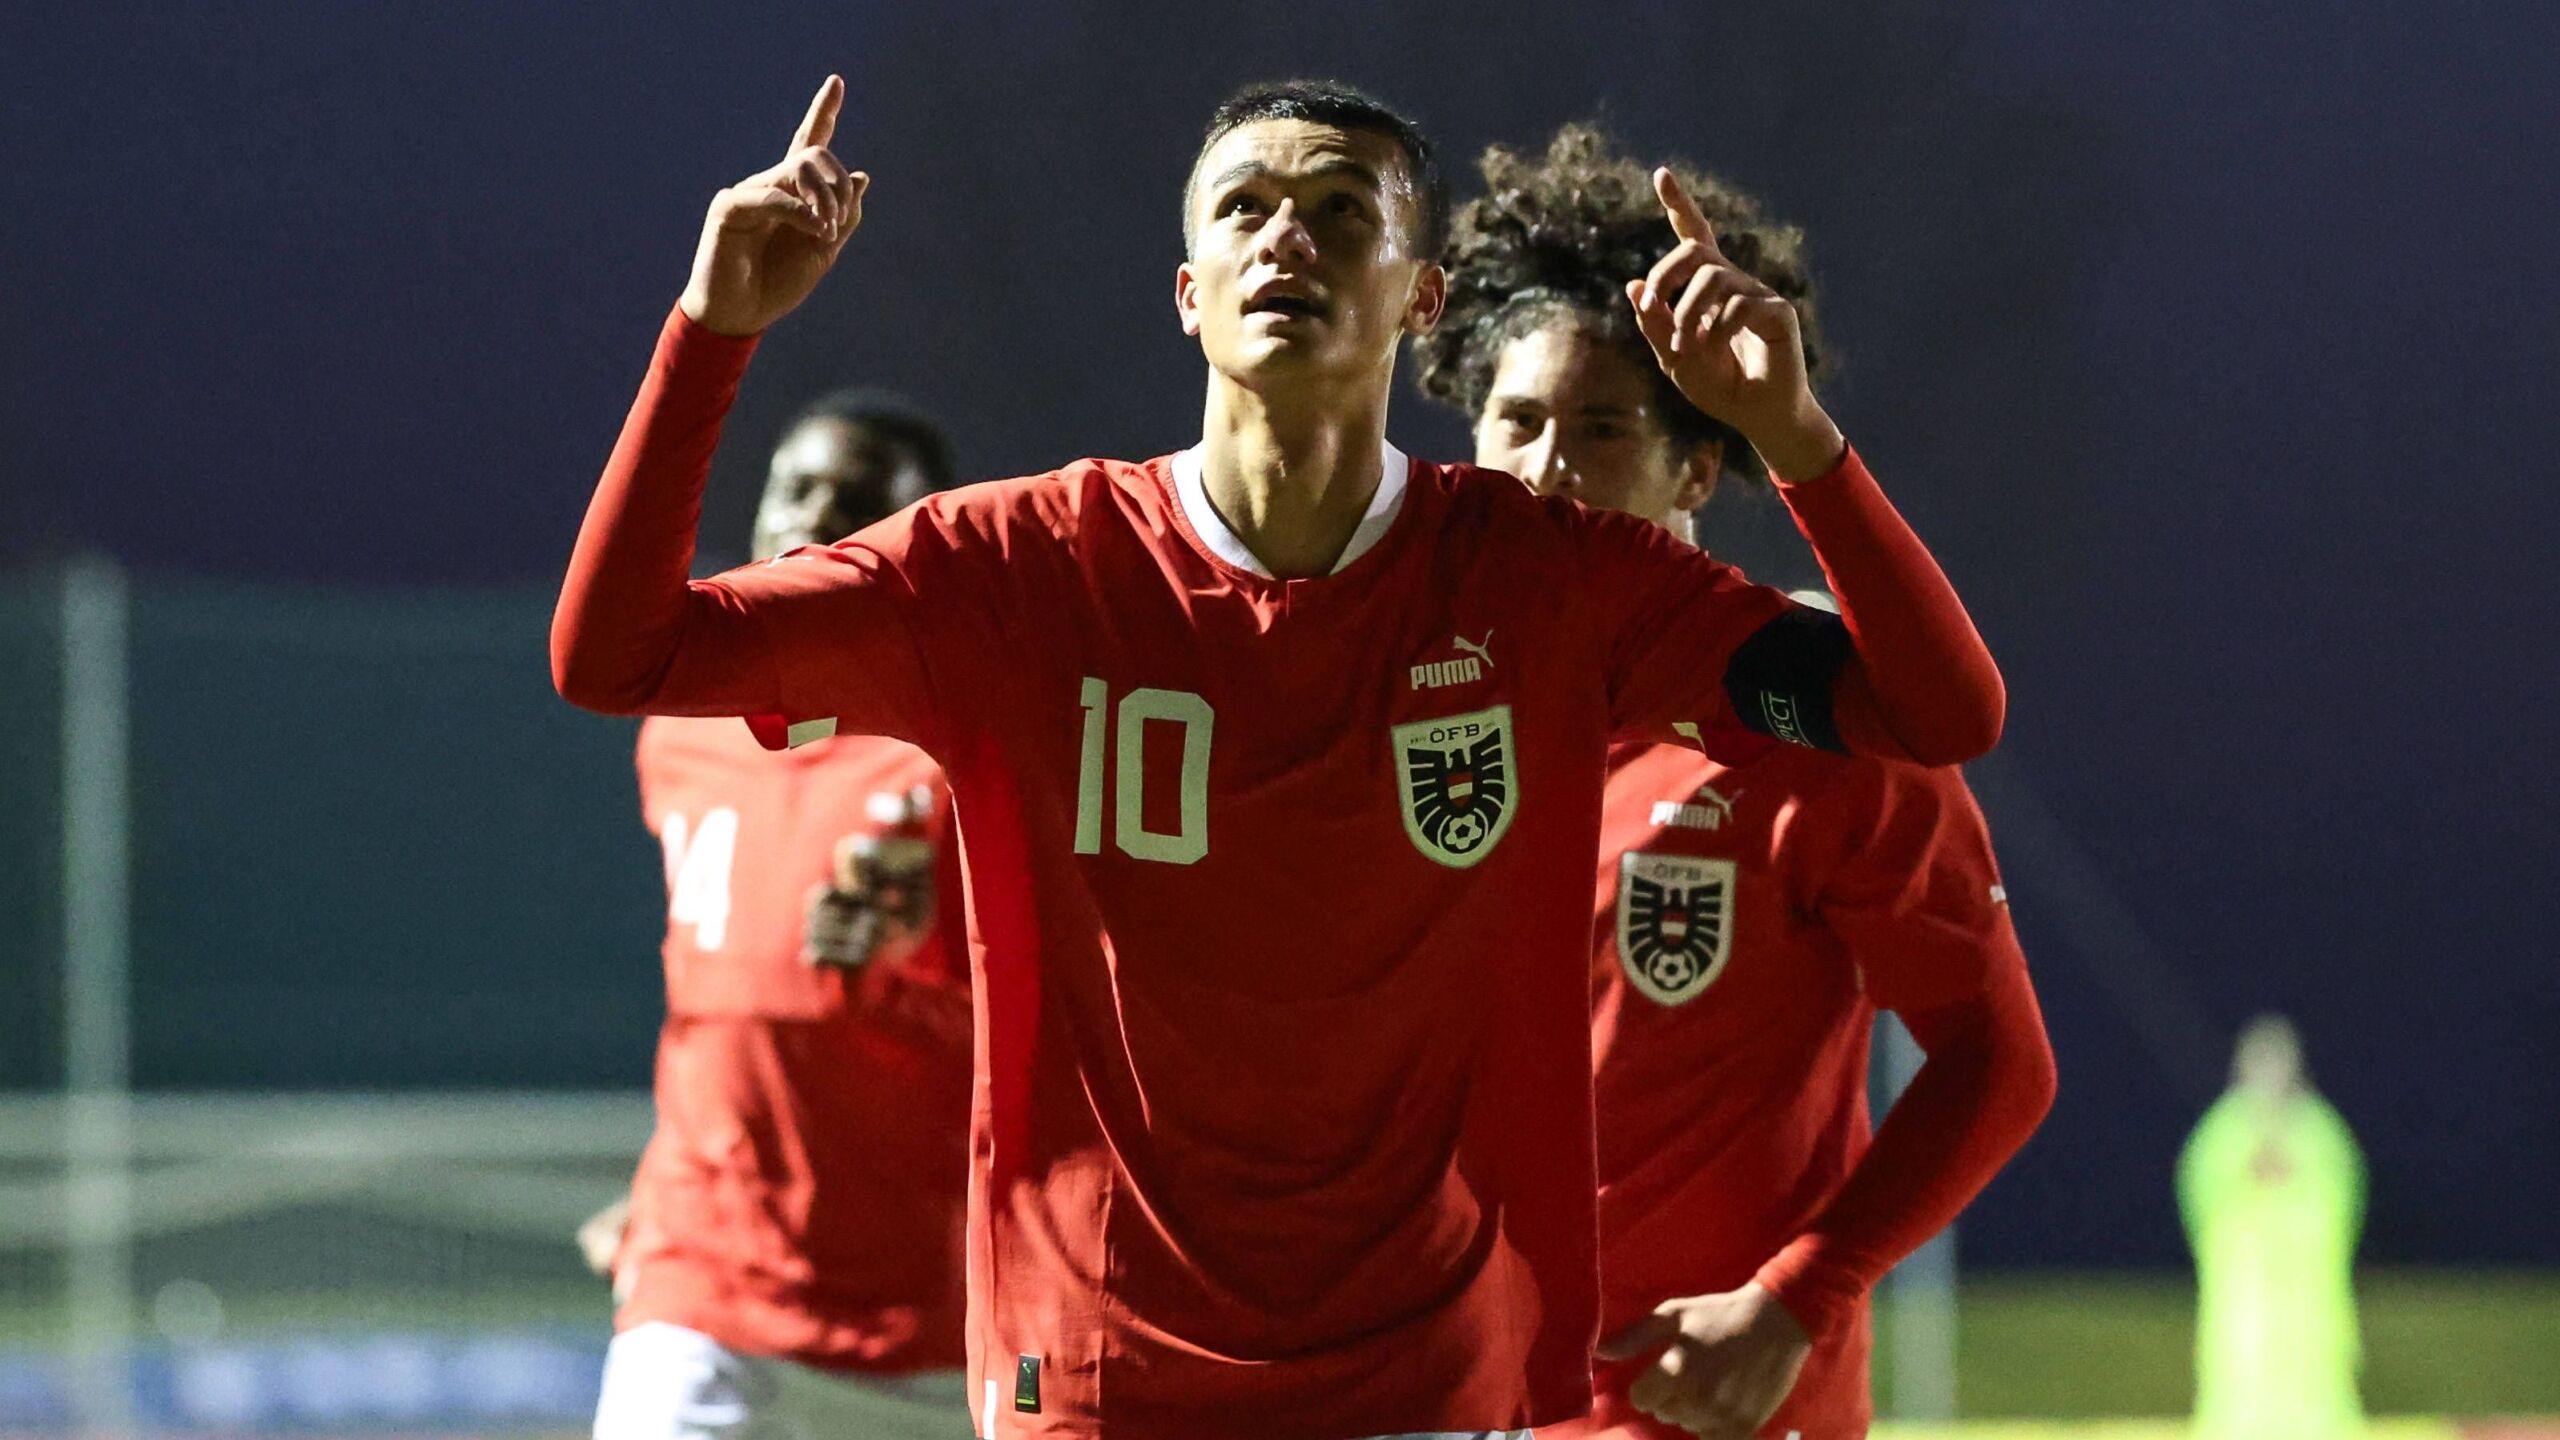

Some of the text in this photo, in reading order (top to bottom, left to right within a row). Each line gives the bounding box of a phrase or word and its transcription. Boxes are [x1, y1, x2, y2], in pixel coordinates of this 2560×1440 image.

[1410, 657, 1481, 690] PUMA
[1429, 723, 1480, 743] ÖFB
[1767, 691, 1800, 740] PECT
[1074, 677, 1214, 865] 10
